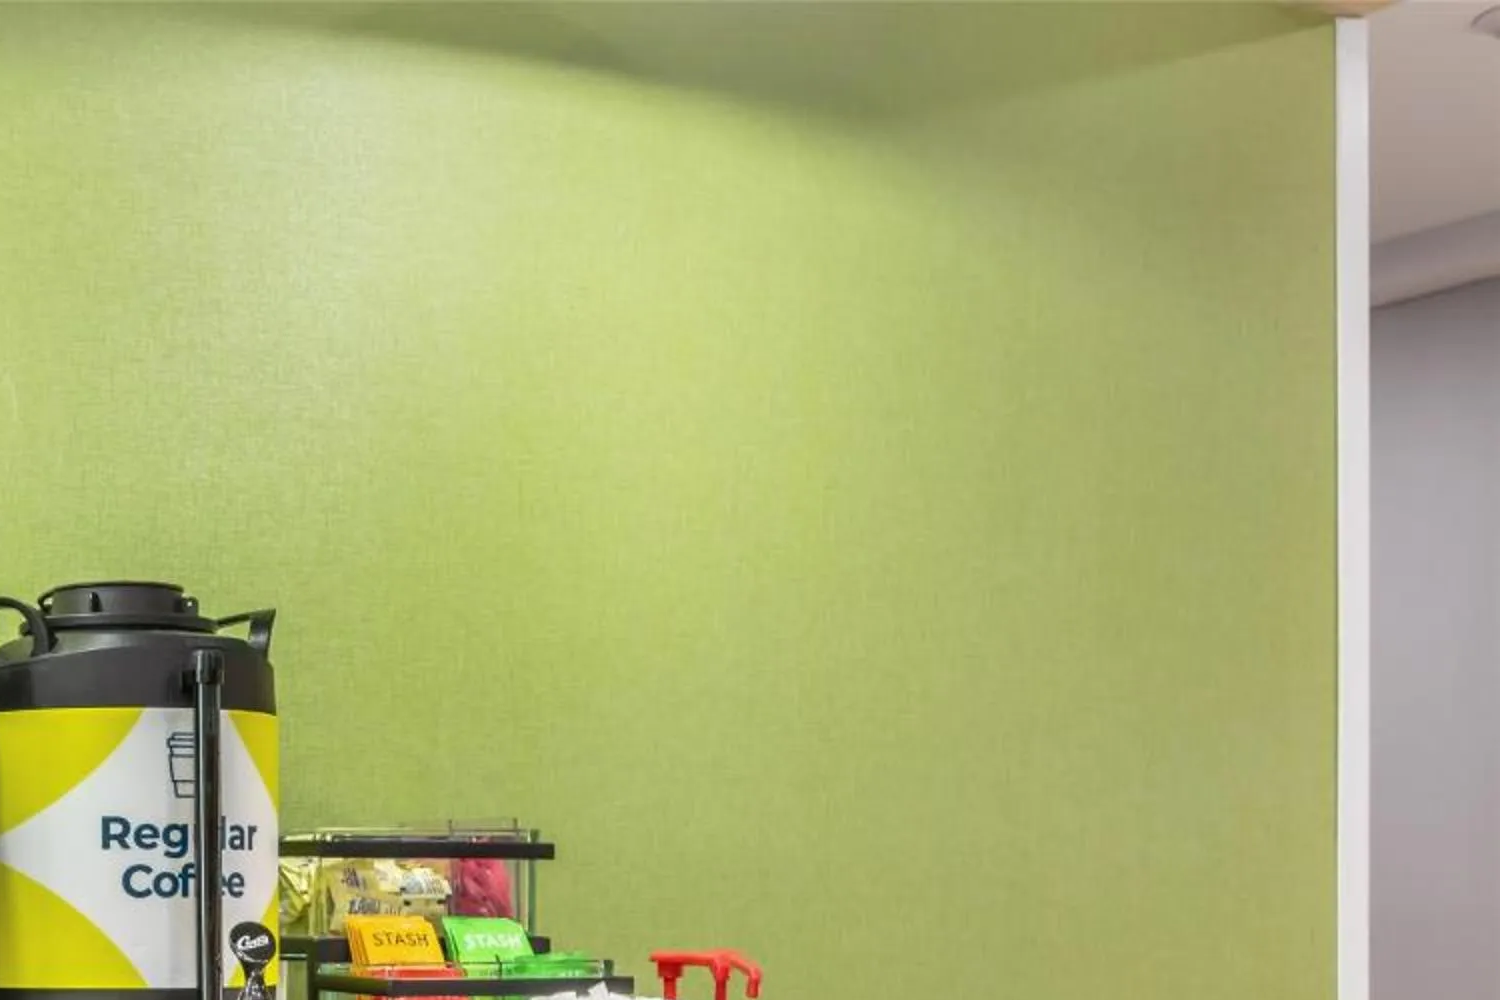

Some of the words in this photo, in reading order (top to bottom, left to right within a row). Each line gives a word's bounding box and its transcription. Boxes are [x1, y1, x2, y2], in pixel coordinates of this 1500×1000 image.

[101, 815, 257, 859] Reglar
[121, 862, 245, 899] Cofe
[372, 931, 429, 948] STASH
[463, 933, 522, 950] STASH
